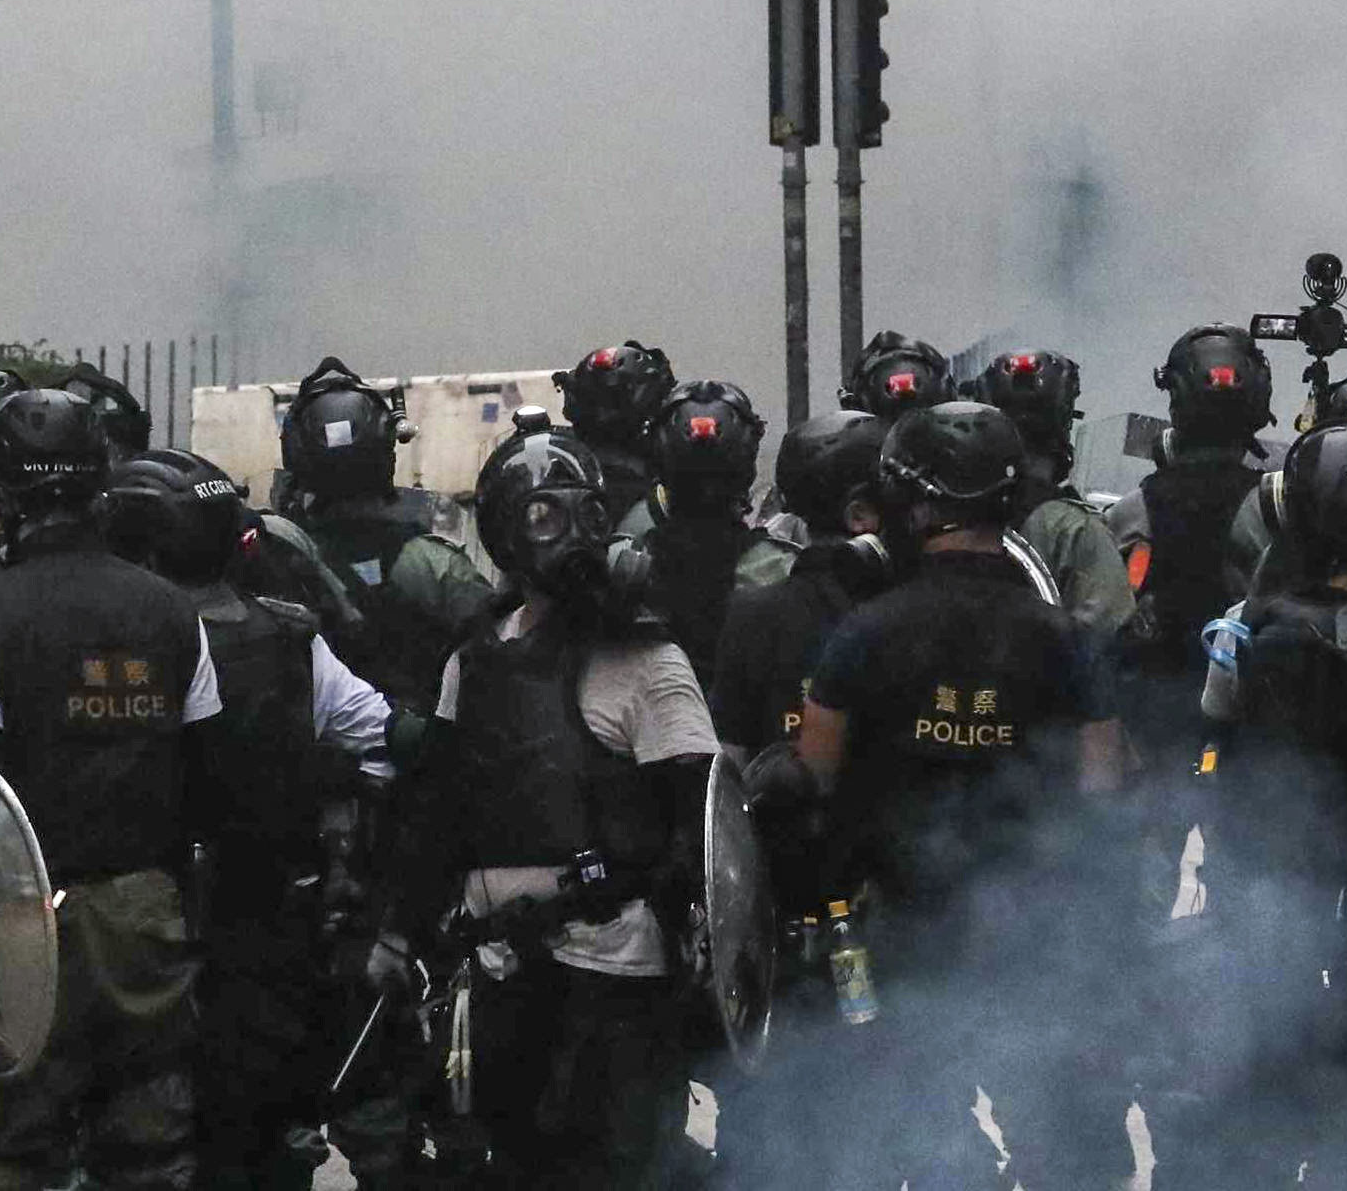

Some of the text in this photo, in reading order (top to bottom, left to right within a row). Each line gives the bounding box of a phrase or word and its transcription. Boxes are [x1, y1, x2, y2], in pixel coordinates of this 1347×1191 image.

[83, 659, 149, 687] 警察
[67, 695, 166, 719] POLICE
[935, 685, 998, 715] 警察
[915, 719, 1013, 746] POLICE
